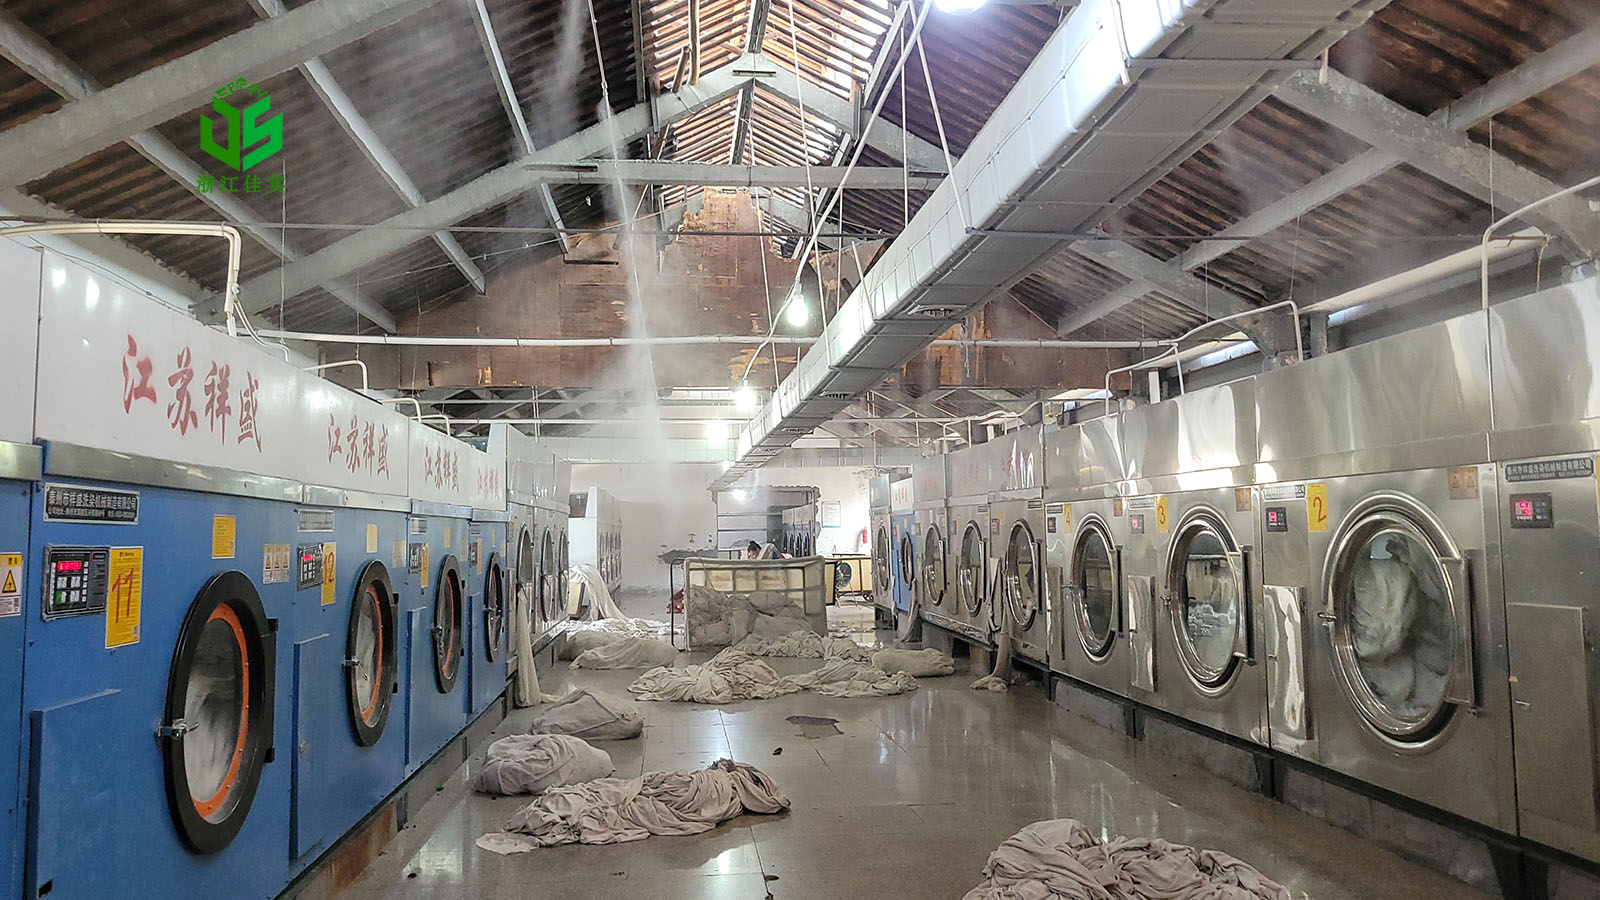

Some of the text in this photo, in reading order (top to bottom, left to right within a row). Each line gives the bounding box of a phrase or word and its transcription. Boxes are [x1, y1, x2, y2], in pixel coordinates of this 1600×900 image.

[123, 333, 262, 453] 江苏祥盛
[327, 413, 390, 480] 江苏祥盛
[1158, 504, 1165, 525] 3
[1313, 496, 1328, 523] 2
[111, 567, 135, 624] 11
